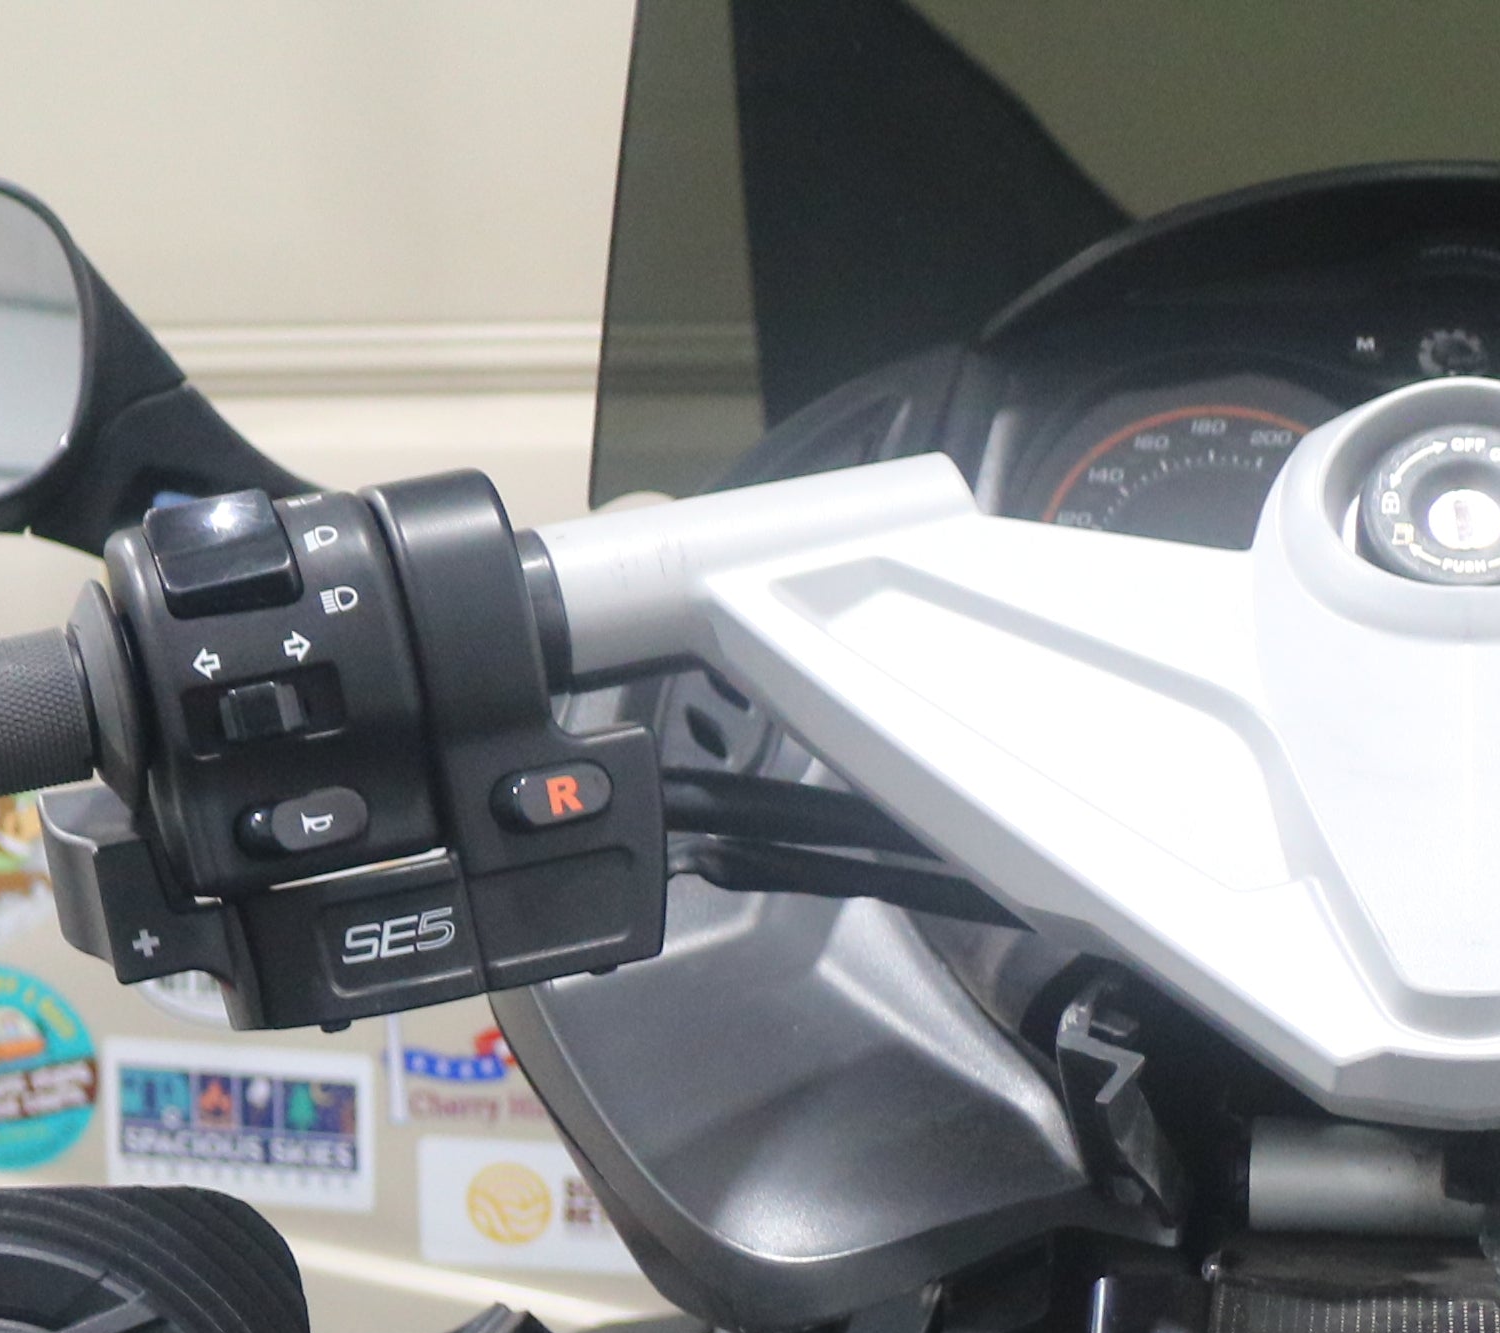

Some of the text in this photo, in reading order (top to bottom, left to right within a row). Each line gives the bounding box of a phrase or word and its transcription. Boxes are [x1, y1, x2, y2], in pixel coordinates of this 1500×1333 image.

[1356, 336, 1376, 352] M
[1250, 430, 1293, 446] 200
[1450, 436, 1486, 453] OFF
[1088, 466, 1125, 484] 140
[1441, 557, 1488, 575] PUSH
[544, 775, 584, 817] R
[341, 906, 456, 966] SE5
[124, 1125, 355, 1168] SPACIOUS SKIES
